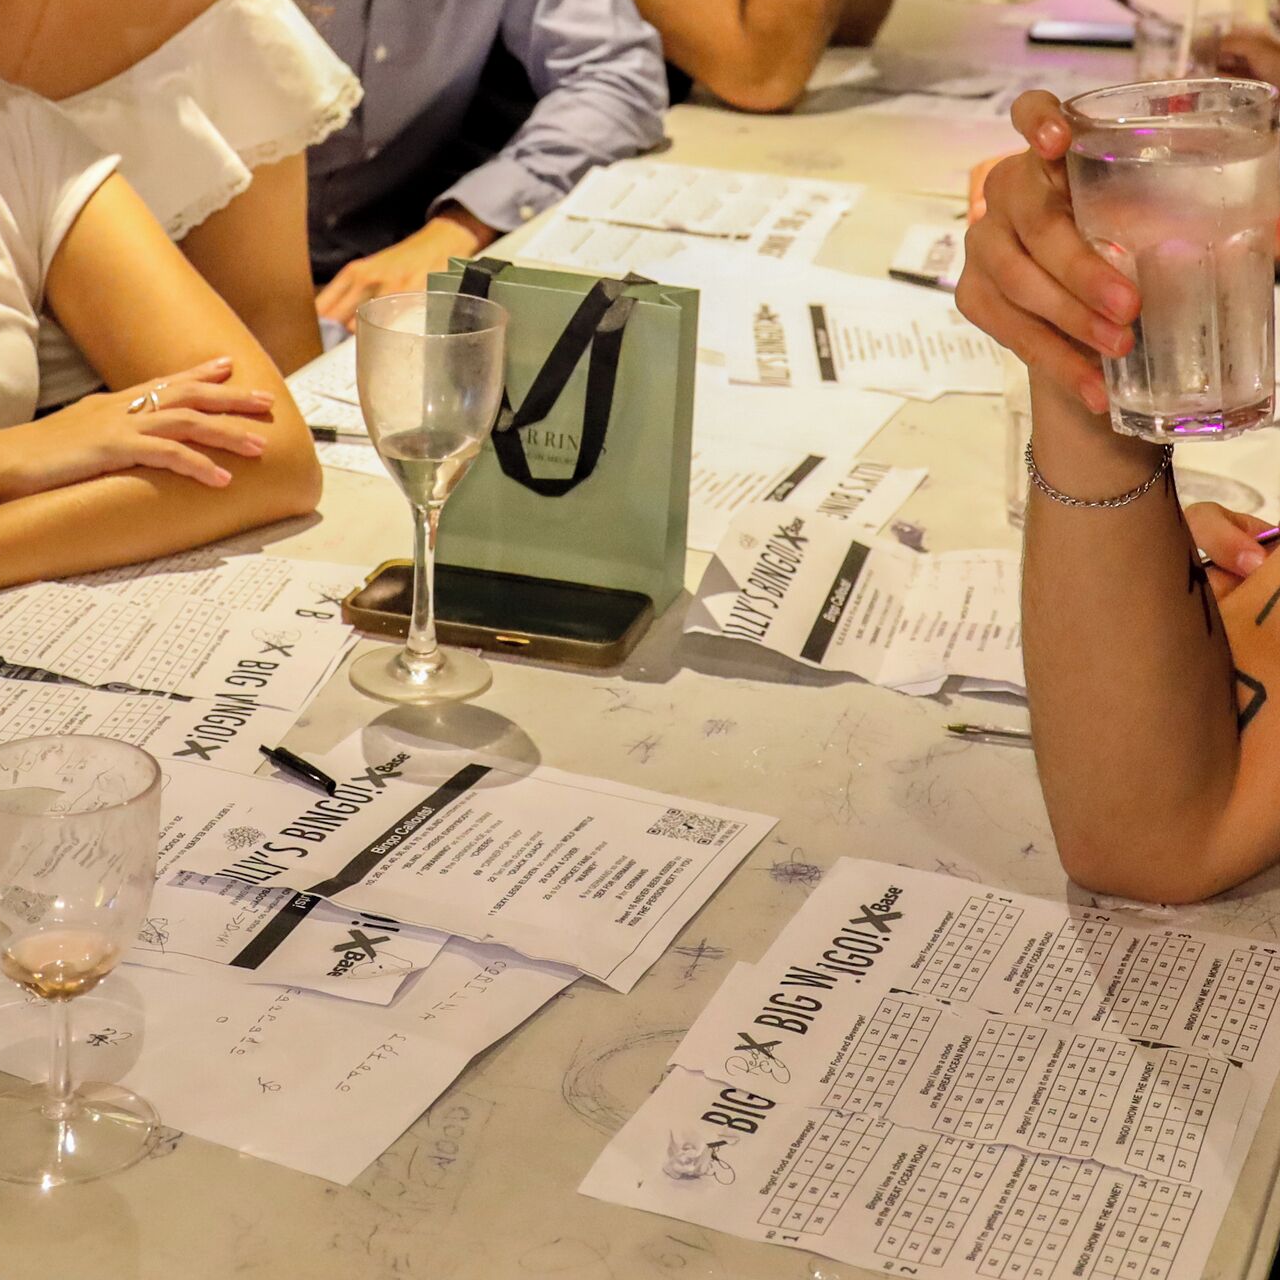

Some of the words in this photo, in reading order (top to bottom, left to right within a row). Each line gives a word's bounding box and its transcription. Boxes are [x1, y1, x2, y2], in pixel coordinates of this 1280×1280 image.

[747, 539, 804, 598] BINGO!
[224, 660, 280, 688] BIG
[215, 842, 308, 889] ILLY'S
[279, 782, 383, 843] BINGO!
[375, 754, 410, 775] Base
[370, 833, 404, 855] Bingo
[393, 804, 436, 836] Callouts!
[934, 911, 954, 932] Beverage!
[920, 941, 934, 953] Food
[930, 932, 940, 941] and
[326, 950, 366, 979] Base
[754, 993, 822, 1034] BIG
[870, 888, 903, 912] Base
[911, 953, 926, 968] Bingo!
[1019, 963, 1035, 980] GREAT
[1029, 946, 1044, 963] OCEAN
[1039, 931, 1053, 946] ROAD!
[1208, 958, 1223, 977] MONEY!
[1204, 977, 1214, 988] THE
[1192, 996, 1206, 1012] SHOW
[845, 1015, 866, 1041] Beverage!
[1184, 1012, 1198, 1030] BINGO!
[840, 1041, 851, 1051] and
[958, 1035, 973, 1052] ROAD!
[831, 1051, 845, 1066] Food
[947, 1052, 963, 1072] OCEAN
[820, 1066, 836, 1083] Bingo!
[920, 1077, 935, 1094] Bingo!
[930, 1063, 943, 1074] love
[936, 1072, 953, 1091] GREAT
[1140, 1061, 1156, 1083] MONEY!
[932, 1092, 943, 1101] the
[1136, 1083, 1147, 1095] THE
[701, 1089, 776, 1133] BIG
[1124, 1105, 1138, 1123] SHOW
[1116, 1123, 1131, 1144] BINGO!
[759, 1175, 778, 1194] Bingo!
[772, 1160, 788, 1175] Food
[784, 1148, 796, 1160] and
[790, 1120, 815, 1148] Beverage!
[910, 1144, 928, 1163] ROAD!
[896, 1163, 916, 1186] OCEAN
[865, 1190, 883, 1209] Bingo!
[879, 1174, 893, 1187] love
[883, 1185, 903, 1207] GREAT
[1105, 1182, 1123, 1207] MONEY!
[878, 1207, 889, 1217] the
[965, 1240, 983, 1261] Bingo!
[977, 1230, 989, 1240] I'm
[984, 1208, 1002, 1230] getting
[1005, 1177, 1017, 1187] the
[1012, 1154, 1029, 1177] shower!
[1099, 1207, 1112, 1220] THE
[1084, 1231, 1100, 1252] SHOW
[1072, 1252, 1090, 1276] BINGO!
